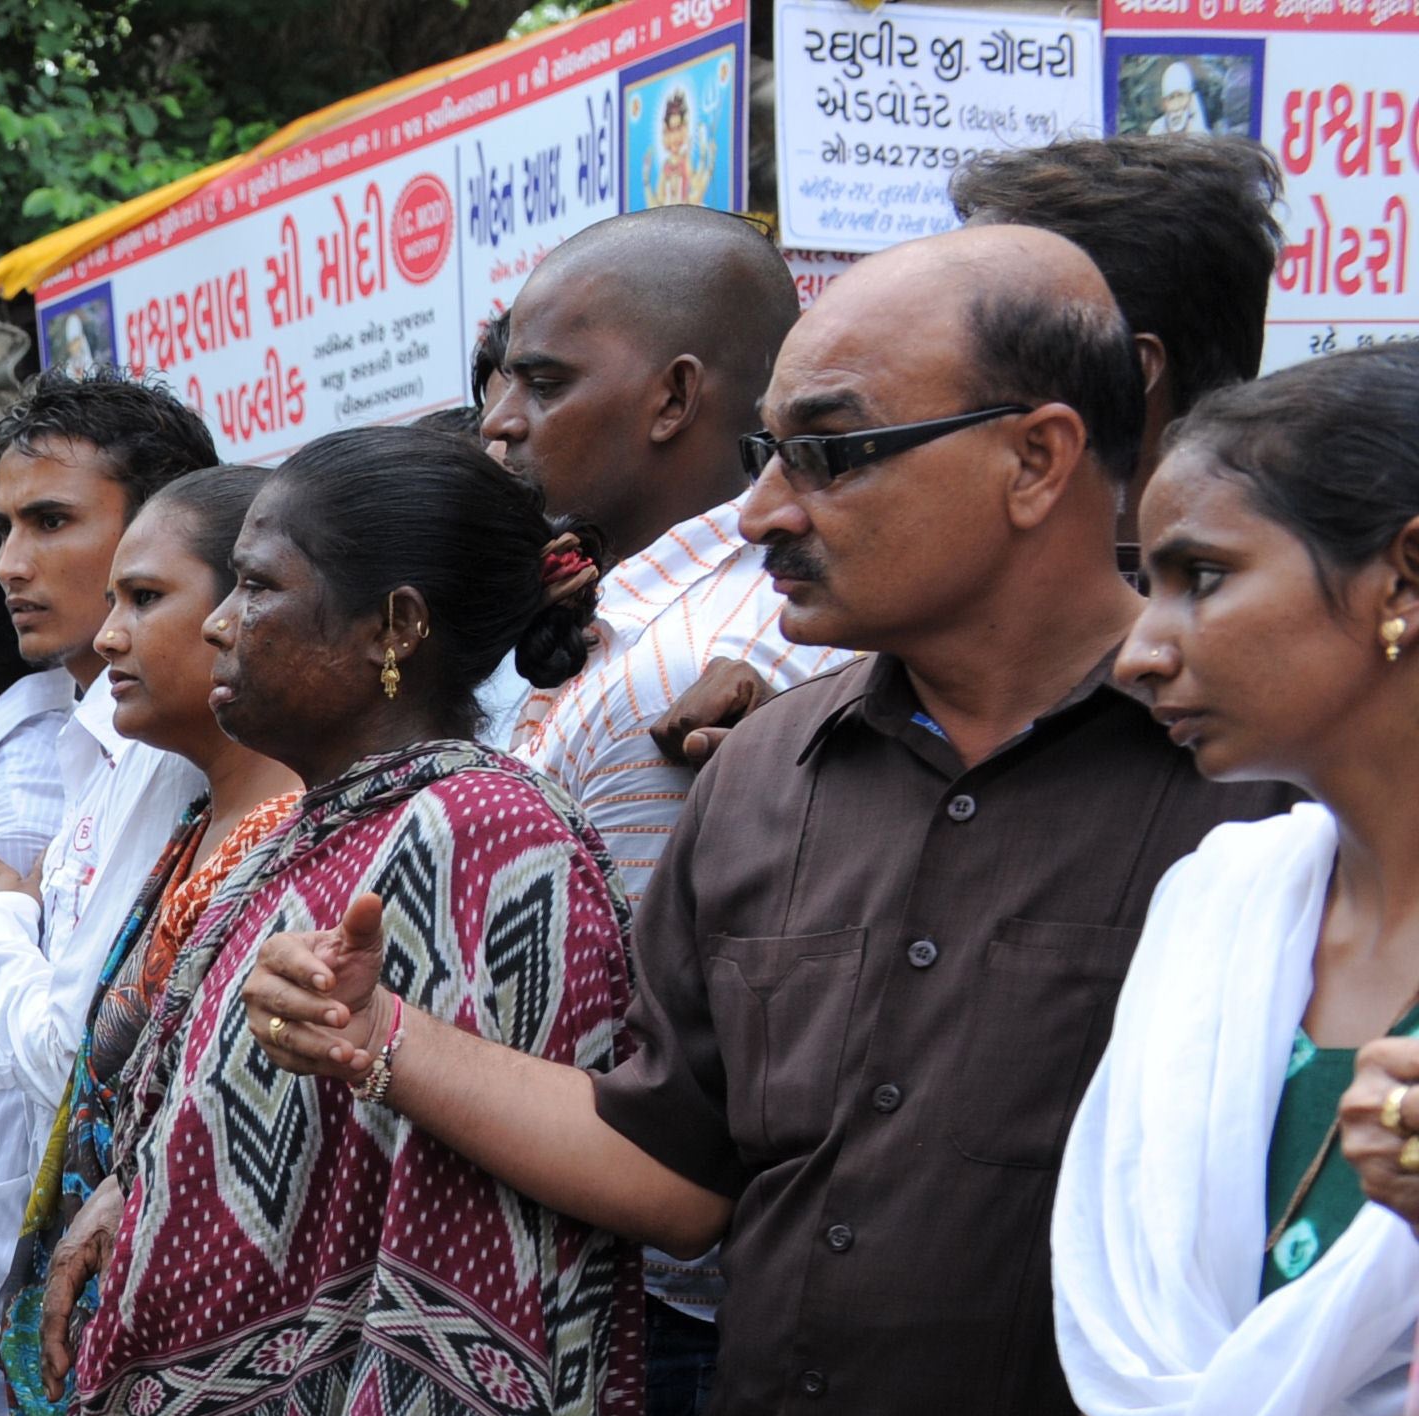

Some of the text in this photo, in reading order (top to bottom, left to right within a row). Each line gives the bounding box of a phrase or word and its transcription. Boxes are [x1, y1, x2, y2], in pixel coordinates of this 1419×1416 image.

[816, 79, 951, 129] એડવોકેટ
[930, 37, 970, 82] જી.
[469, 140, 514, 247] મોહન
[578, 89, 614, 208] મોદી
[1281, 82, 1419, 177] ઇશ્વર
[318, 181, 386, 306] મોદી
[1276, 194, 1408, 296] નોટરી
[392, 307, 435, 341] ગુજરાત
[216, 347, 306, 443] પબ્લીક
